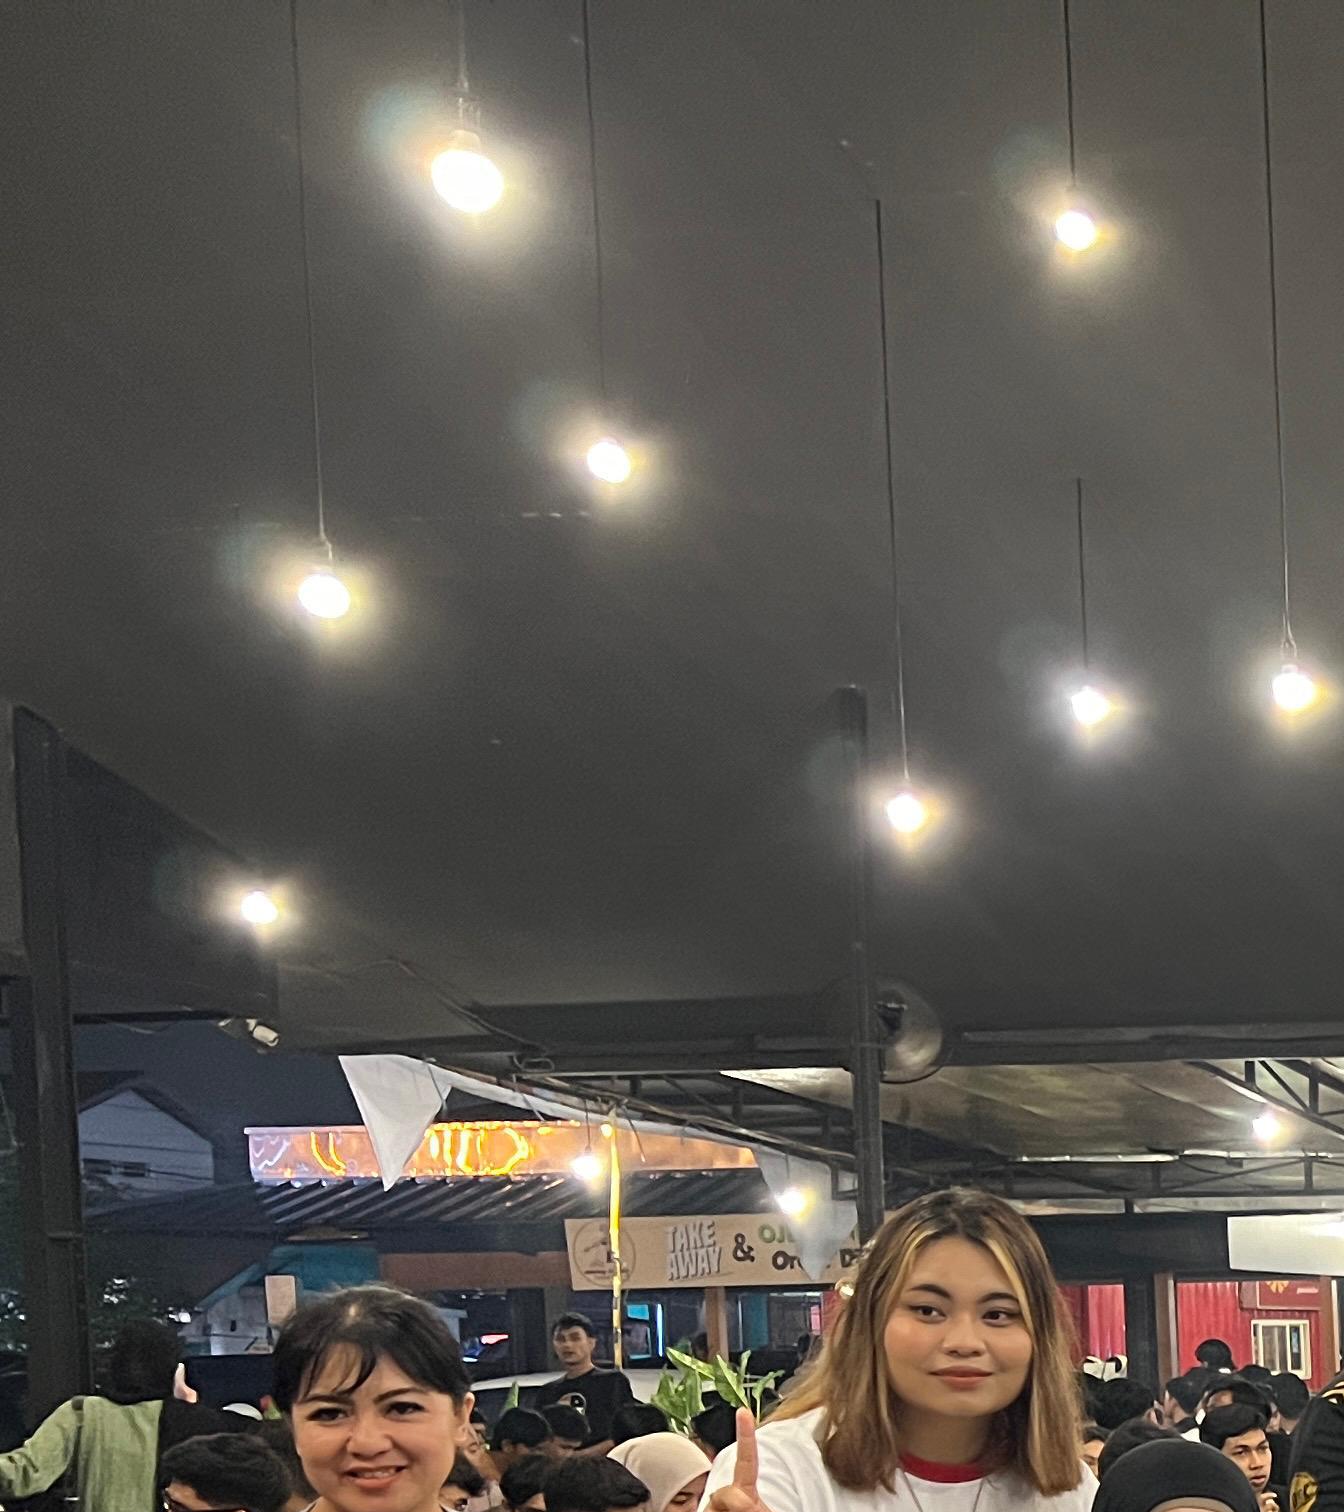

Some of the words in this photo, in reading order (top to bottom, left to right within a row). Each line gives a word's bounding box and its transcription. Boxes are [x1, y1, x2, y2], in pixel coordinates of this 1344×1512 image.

[666, 1221, 716, 1254] TAKE
[733, 1232, 755, 1262] &
[667, 1246, 722, 1281] AWAY
